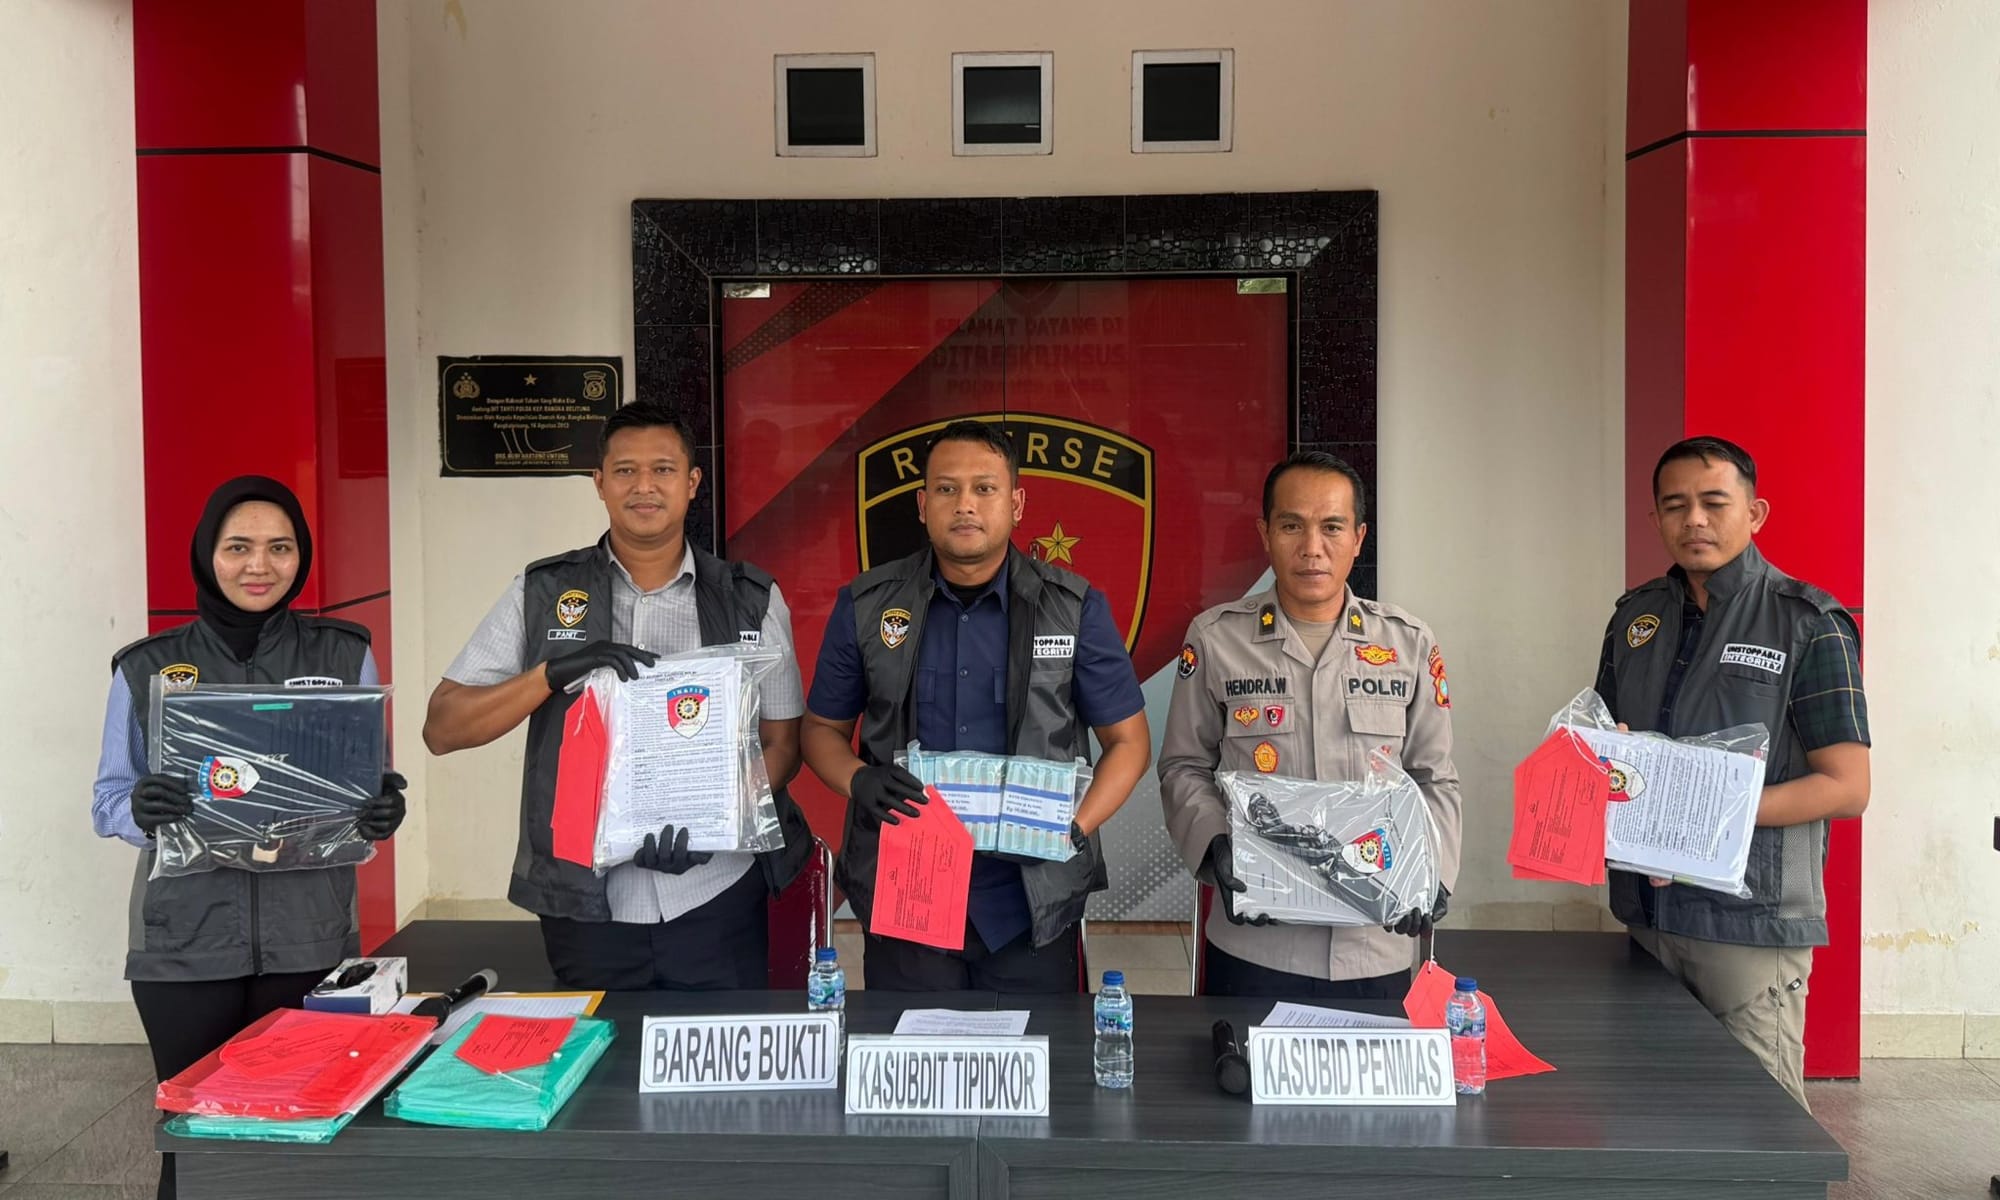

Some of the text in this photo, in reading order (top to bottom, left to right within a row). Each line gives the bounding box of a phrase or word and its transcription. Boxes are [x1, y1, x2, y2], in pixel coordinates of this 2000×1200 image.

[1722, 653, 1782, 672] INTEGRITY
[1727, 646, 1783, 661] UNSTOPPABLE
[1225, 678, 1286, 696] HENDRA.W
[1348, 678, 1407, 697] POLRI
[652, 1024, 827, 1083] BARANG BUKTI
[1261, 1037, 1351, 1096] KASUBID
[1356, 1037, 1441, 1096] PENMAS
[857, 1050, 1036, 1110] KASUBDIT TIPIDKOR
